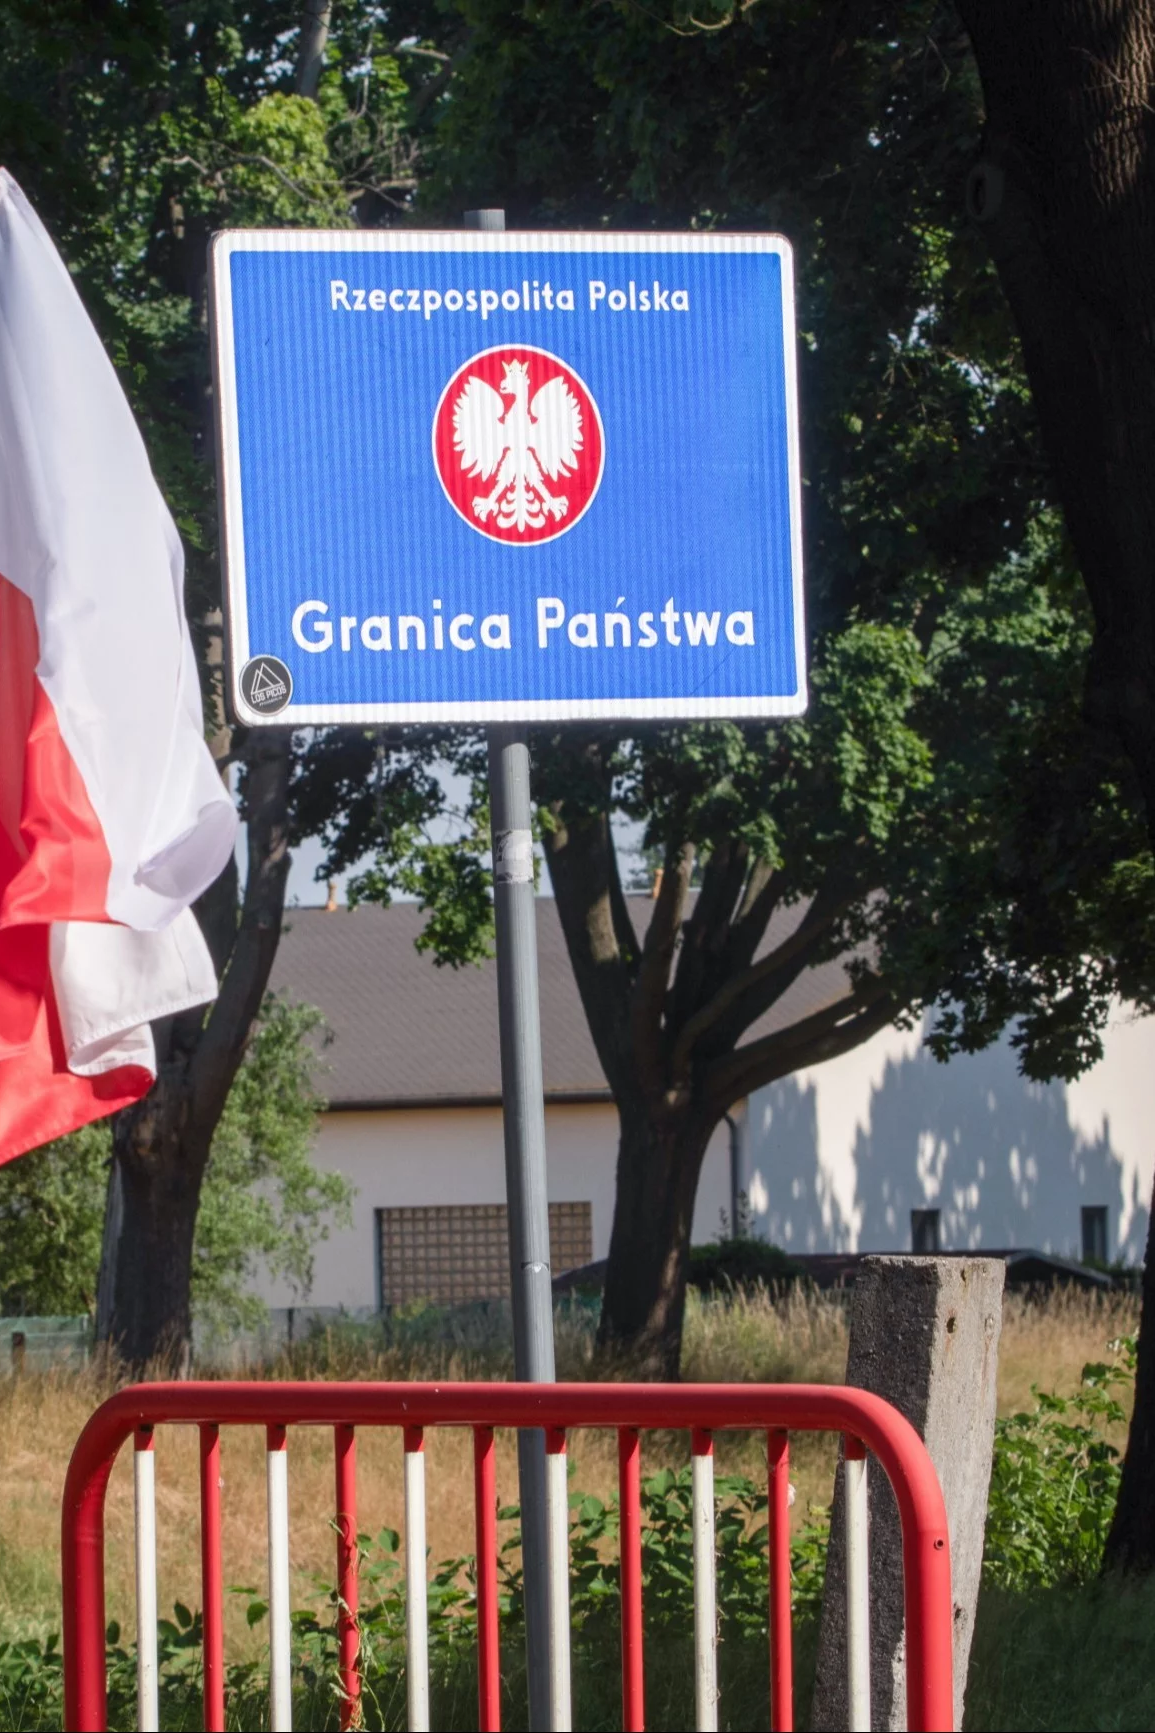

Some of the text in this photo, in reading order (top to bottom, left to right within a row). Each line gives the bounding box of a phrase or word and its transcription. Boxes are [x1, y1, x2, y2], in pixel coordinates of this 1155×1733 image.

[330, 280, 689, 320] Rzeczpospolita Polska
[291, 597, 755, 653] Granica Państwa
[251, 692, 265, 704] LOS
[266, 685, 287, 699] PICOS
